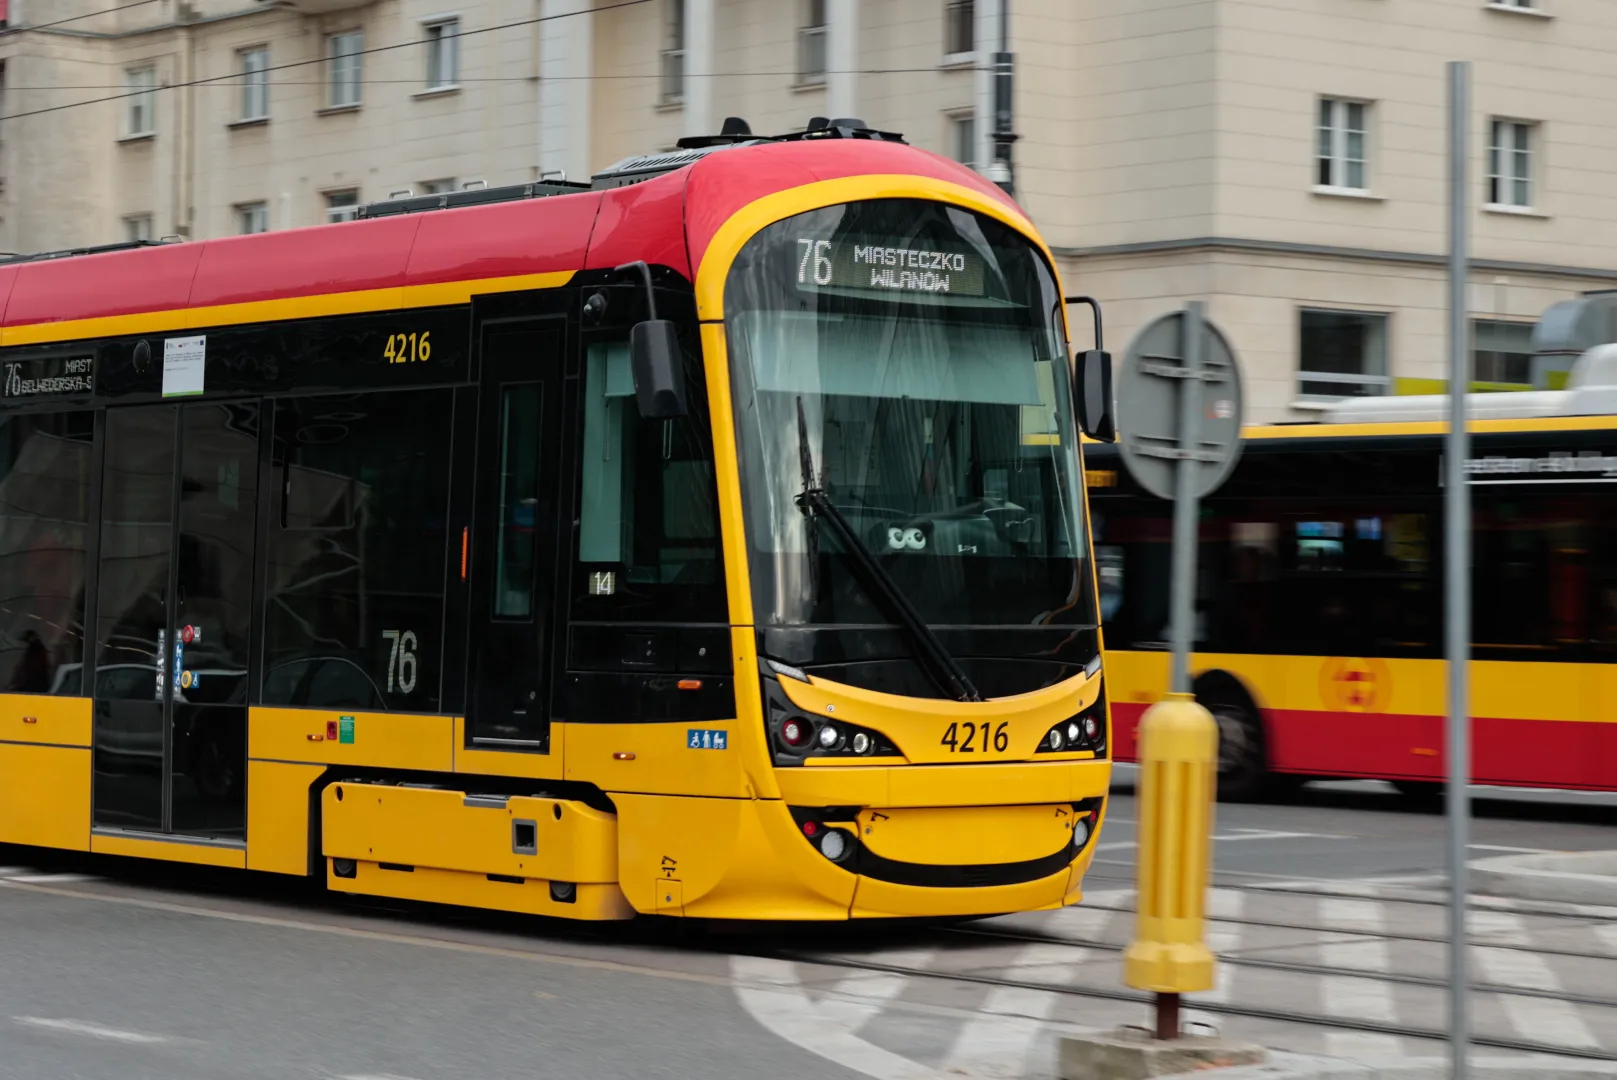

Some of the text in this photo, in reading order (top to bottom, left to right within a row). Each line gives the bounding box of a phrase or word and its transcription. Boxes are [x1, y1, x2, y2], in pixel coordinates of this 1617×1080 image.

[798, 239, 832, 286] 76
[854, 245, 965, 271] MIASTECZKO
[384, 331, 430, 364] 4216
[5, 363, 21, 396] 76
[65, 359, 92, 374] MIAST
[595, 571, 611, 595] 14
[382, 629, 417, 694] 76
[941, 721, 1009, 753] 4216
